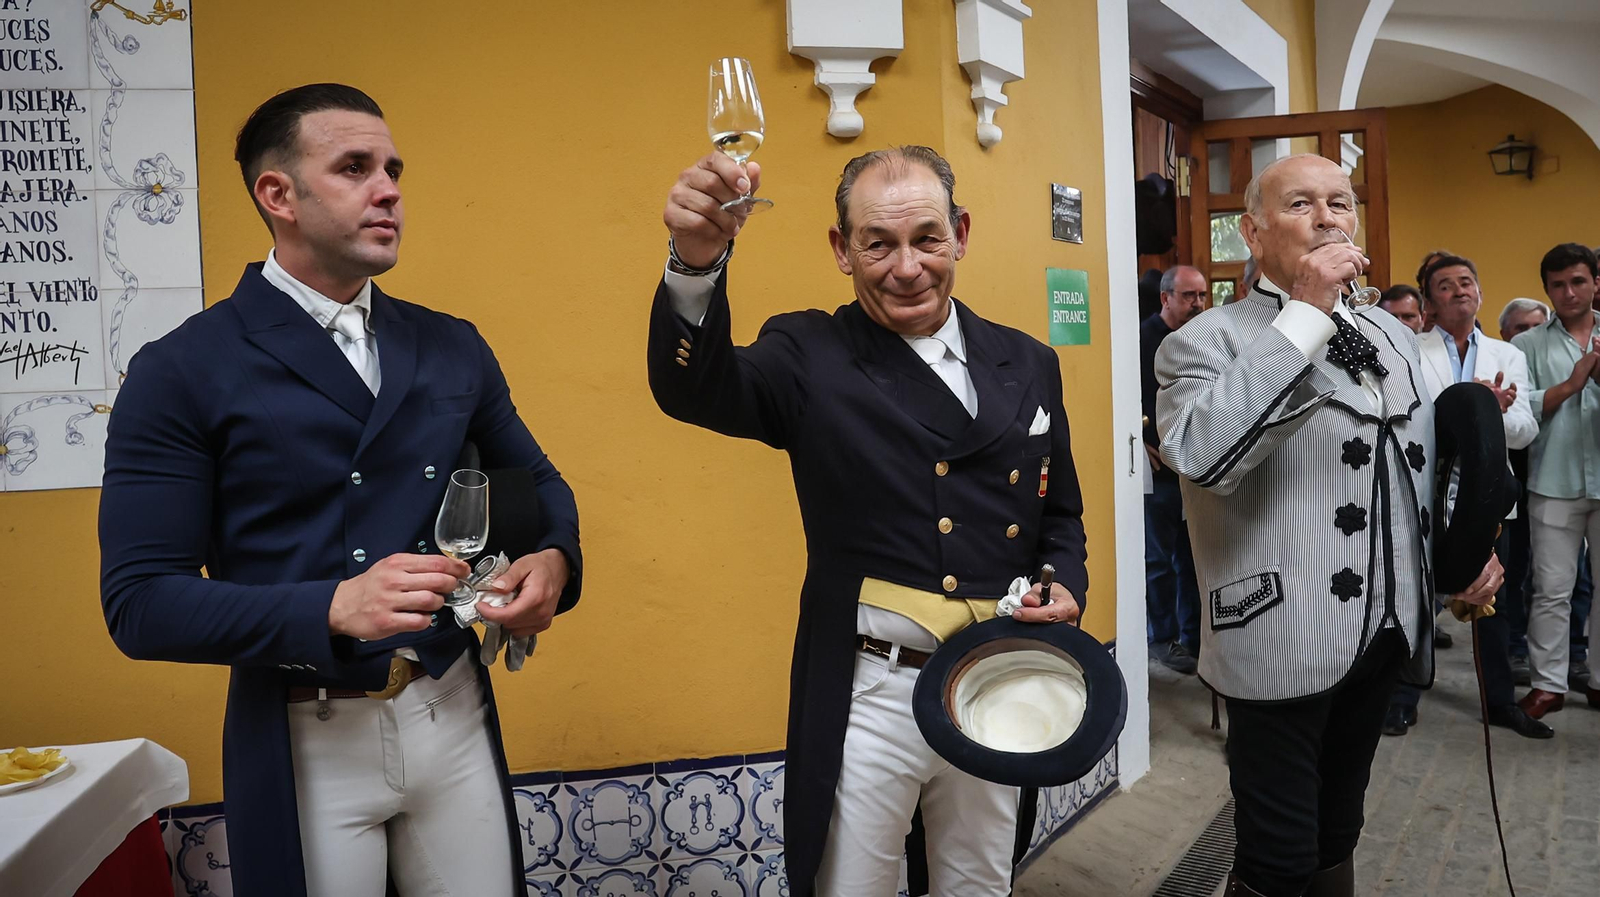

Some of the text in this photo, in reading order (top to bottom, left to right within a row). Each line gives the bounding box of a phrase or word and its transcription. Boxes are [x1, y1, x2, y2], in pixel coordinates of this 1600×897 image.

[0, 48, 64, 74] UCES.
[0, 87, 87, 117] ISIERA,
[0, 146, 93, 175] ROMETE,
[26, 277, 98, 306] VIENTO
[1053, 291, 1085, 305] ENTRADA
[0, 310, 58, 334] NTO.
[1053, 310, 1087, 323] ENTRANCE
